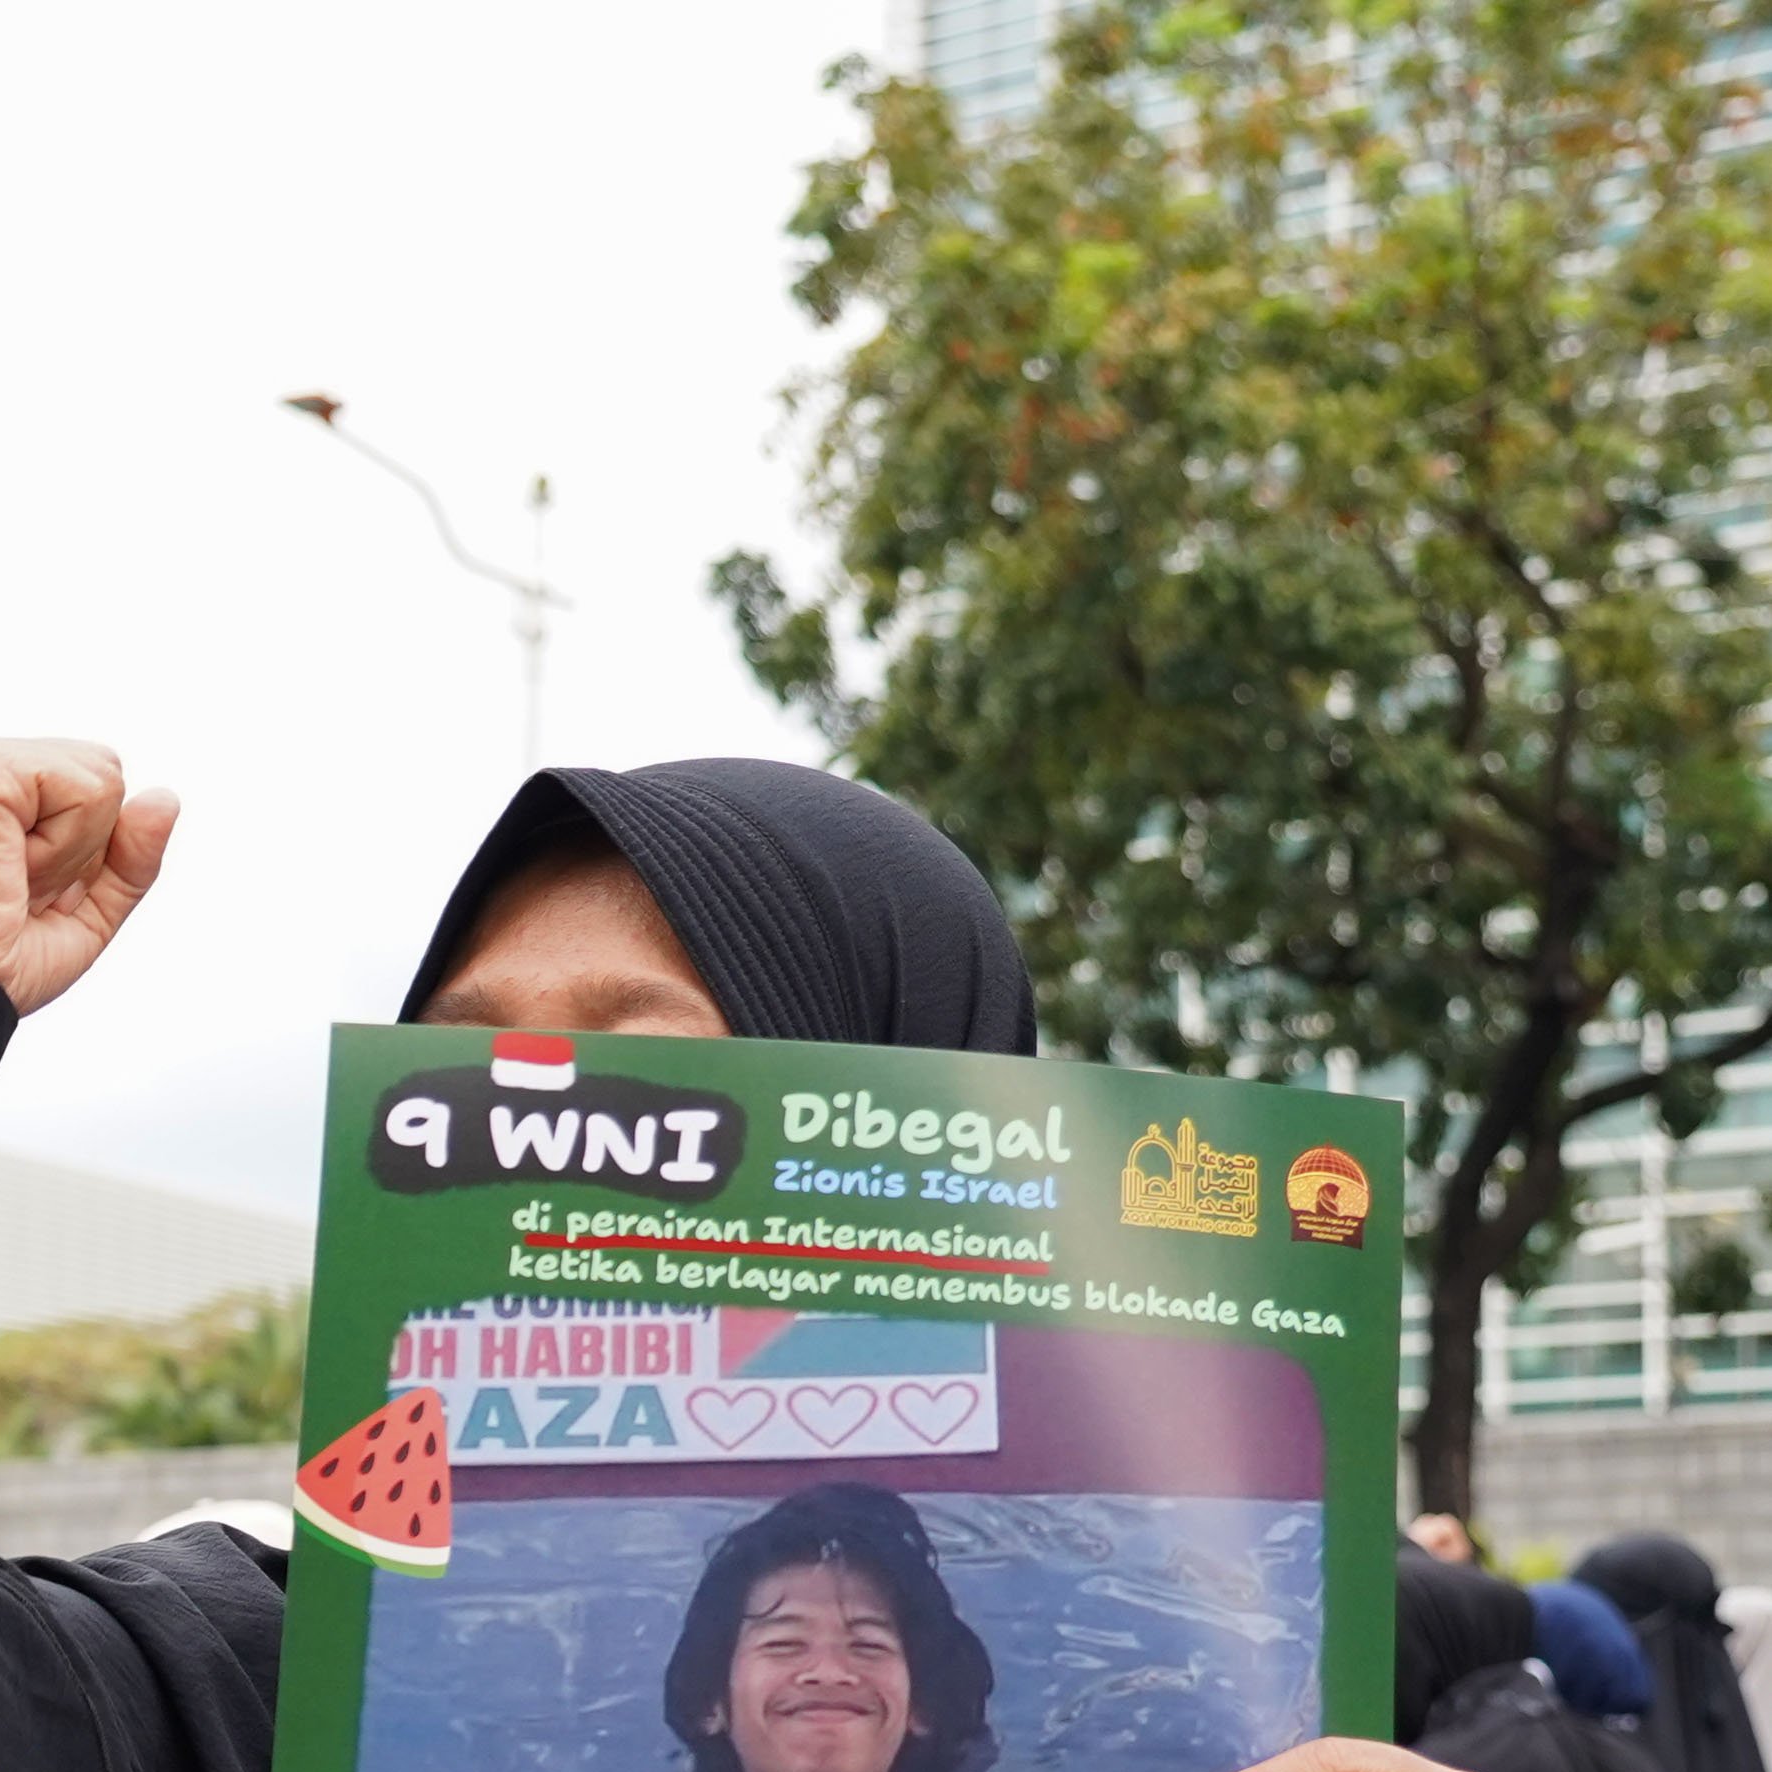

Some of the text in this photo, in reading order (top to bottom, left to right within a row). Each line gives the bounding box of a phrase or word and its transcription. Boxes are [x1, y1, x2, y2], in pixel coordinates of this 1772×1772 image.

[386, 1097, 719, 1182] 9 WNI
[781, 1089, 1071, 1174] Dibegal
[773, 1160, 1057, 1209] Zionis Israel
[512, 1200, 1054, 1263] di perairan Internasional
[1121, 1211, 1257, 1237] AQSA WORKING GROUP
[509, 1245, 1345, 1338] ketika berlayar menembus blokade Gaza
[479, 1323, 693, 1379] HABIBI
[388, 1384, 679, 1450] AZA
